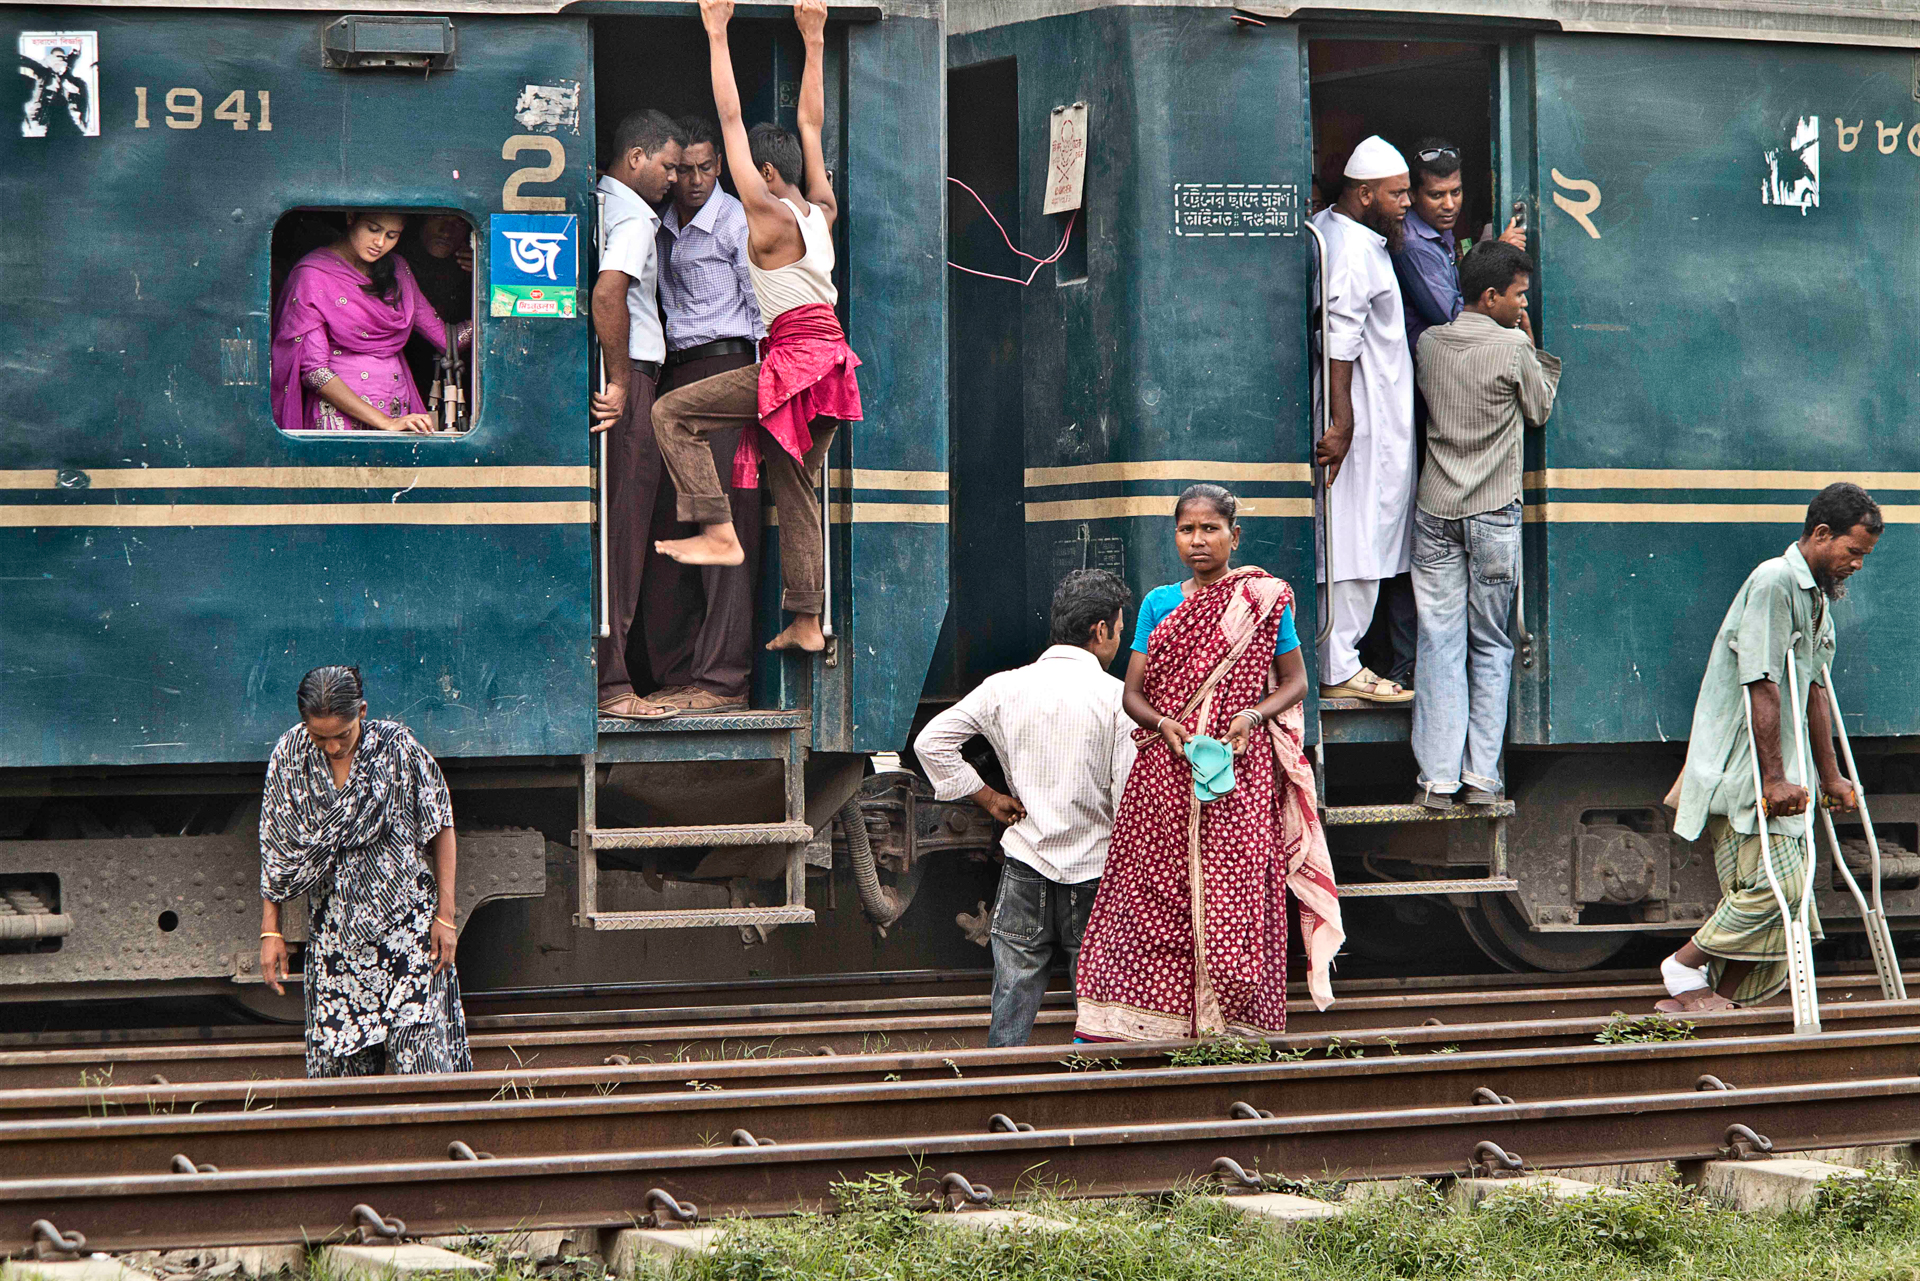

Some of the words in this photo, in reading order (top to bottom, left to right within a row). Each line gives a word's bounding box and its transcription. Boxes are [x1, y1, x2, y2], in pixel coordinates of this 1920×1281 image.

[134, 86, 273, 131] 1941
[501, 134, 566, 211] 2
[1182, 188, 1226, 209] ট্রেনের
[1227, 192, 1259, 209] ছাদে
[1551, 167, 1602, 239] ২
[501, 231, 569, 281] জ
